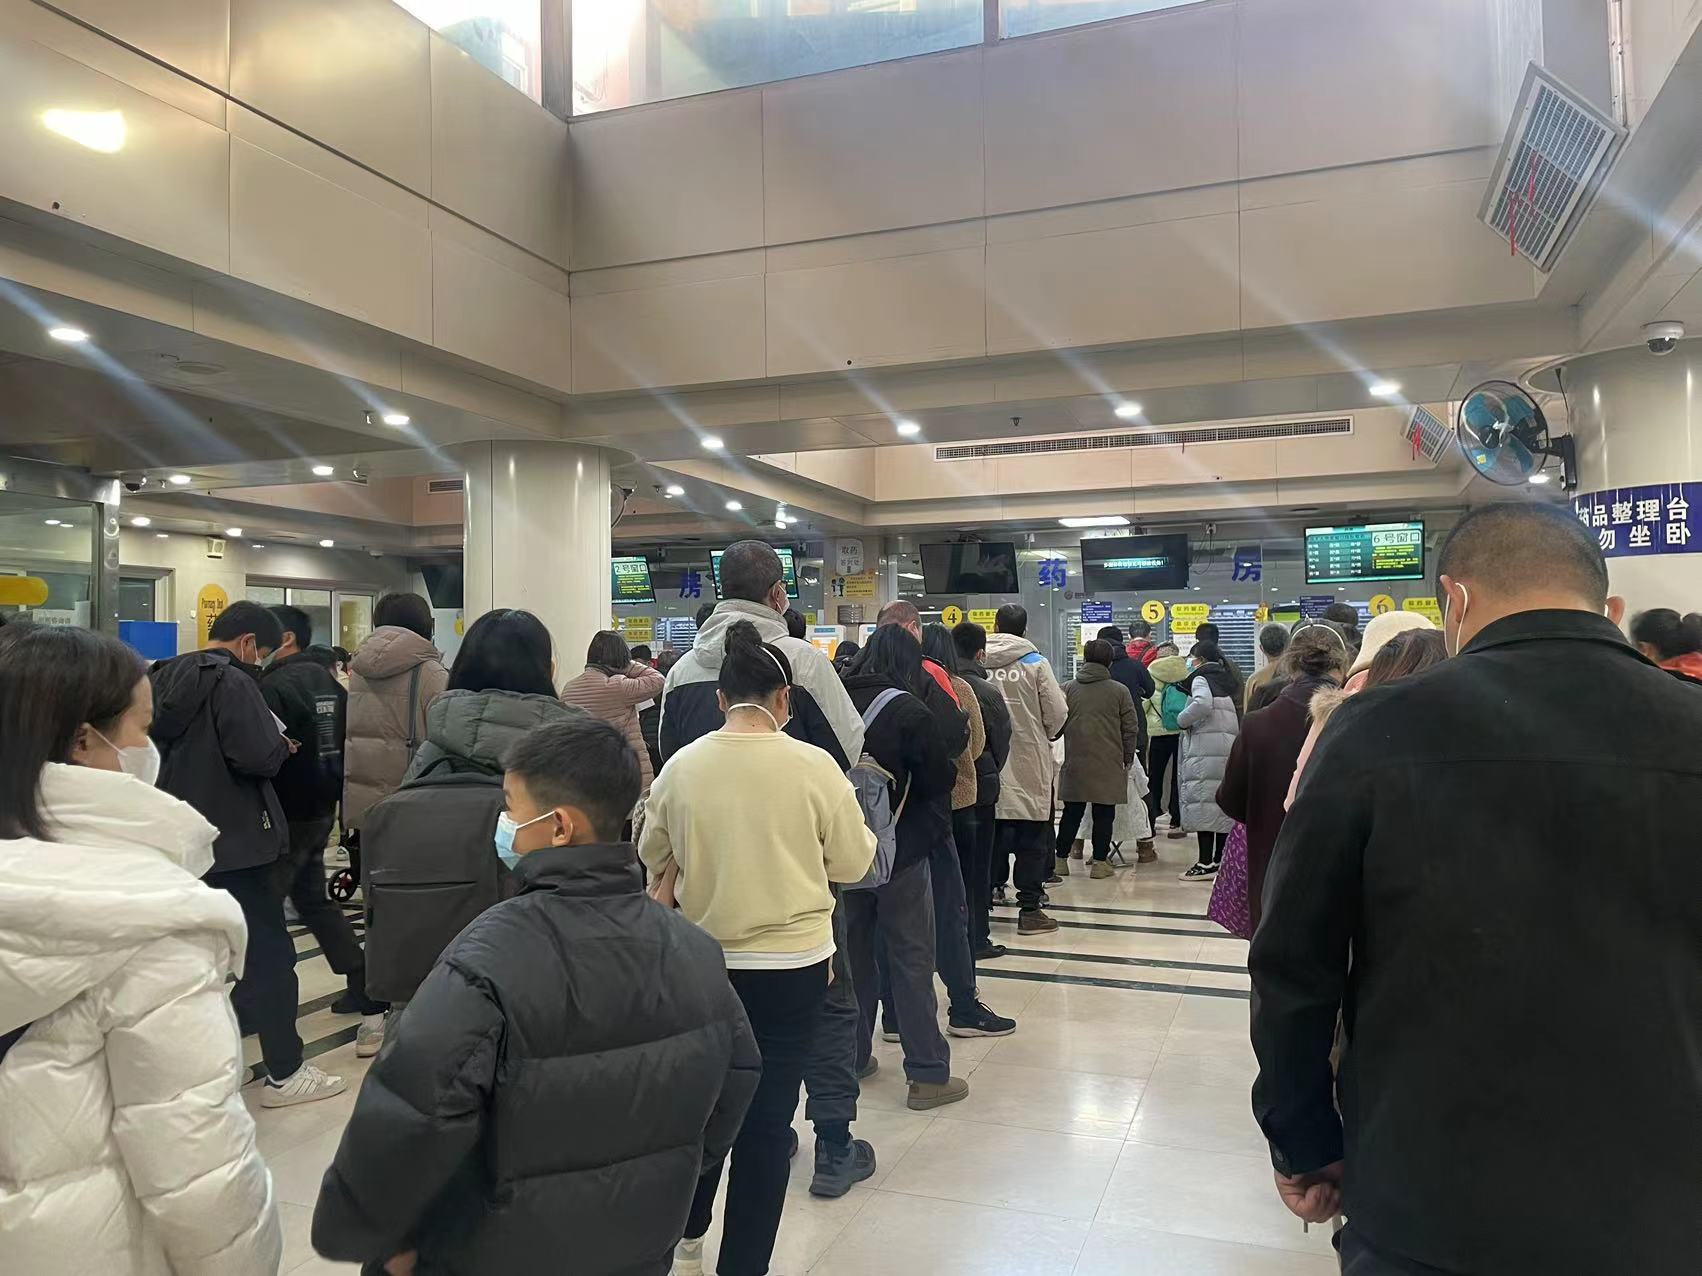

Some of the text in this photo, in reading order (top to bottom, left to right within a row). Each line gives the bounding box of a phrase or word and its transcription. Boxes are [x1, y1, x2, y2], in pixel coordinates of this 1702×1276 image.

[1579, 497, 1689, 527] 药品整理台
[1373, 532, 1420, 543] 6号窗口
[615, 563, 647, 574] 2号窗口
[1038, 558, 1067, 588] 药
[947, 608, 957, 624] 4
[1149, 604, 1159, 620] 5
